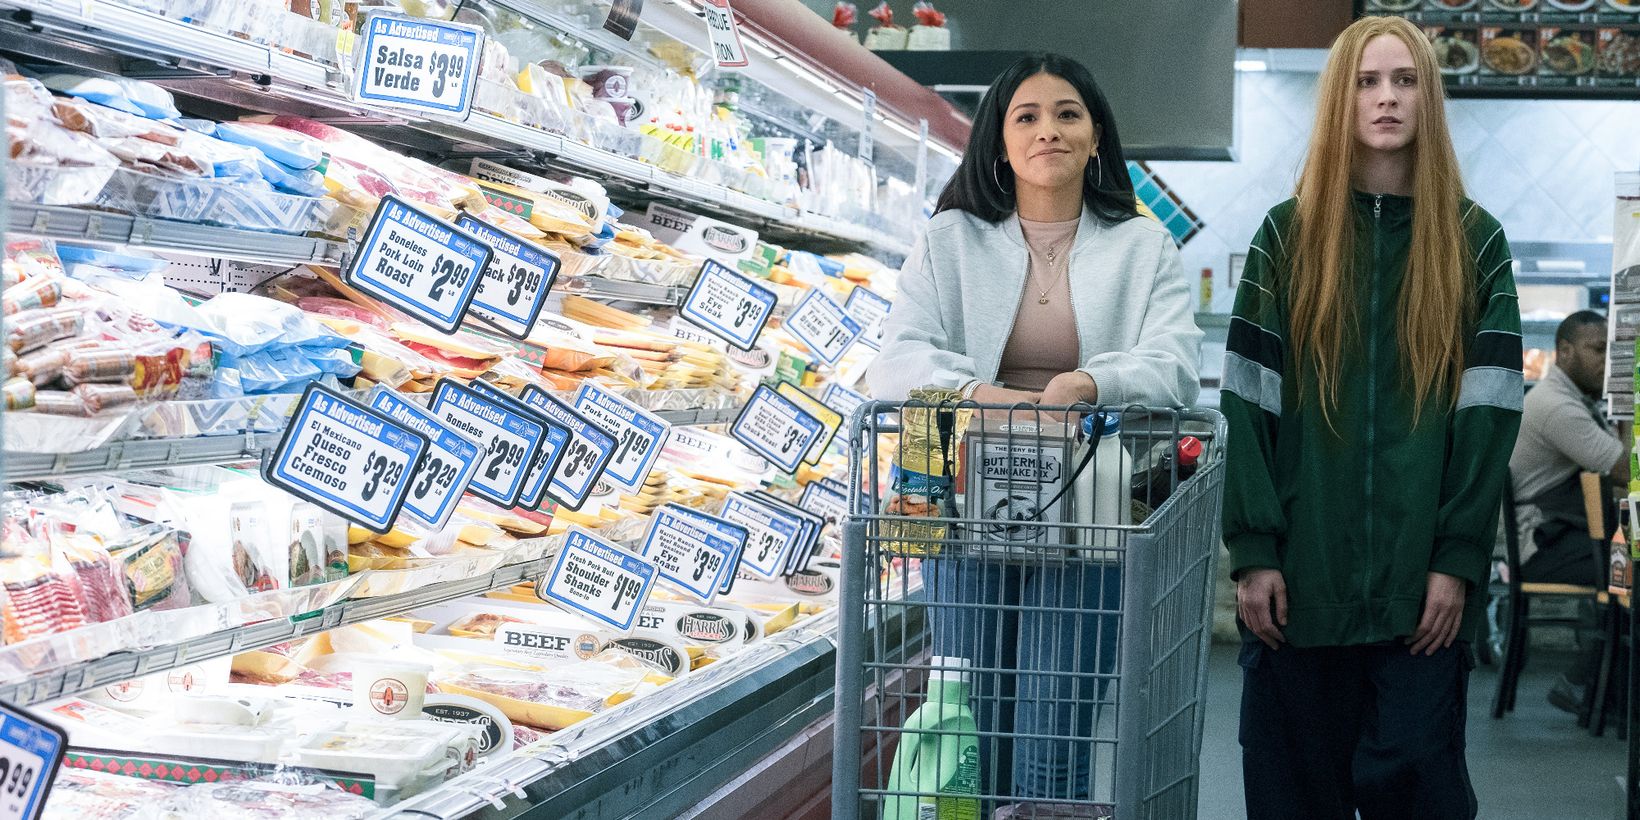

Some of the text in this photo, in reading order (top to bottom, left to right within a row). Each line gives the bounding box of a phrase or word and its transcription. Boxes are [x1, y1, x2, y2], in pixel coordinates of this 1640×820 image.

[374, 20, 388, 34] As
[389, 21, 439, 42] Advertised
[376, 45, 424, 70] Salsa
[374, 67, 420, 91] Verde
[389, 204, 452, 246] As Advertised
[651, 213, 693, 233] BEEF
[389, 230, 428, 256] Boneless
[464, 222, 520, 255] As Advertised
[379, 242, 424, 273] Pork Loin
[376, 257, 414, 288] Roast
[485, 267, 505, 282] ack
[700, 302, 723, 319] Steak
[707, 297, 723, 310] Eye
[312, 395, 383, 438] As Advertised
[444, 387, 458, 402] As
[458, 392, 504, 425] Advertised
[533, 392, 544, 404] As
[544, 396, 584, 431] Advertised
[584, 403, 602, 418] Pork
[604, 414, 620, 428] Loin
[585, 386, 636, 421] As Advertised
[378, 396, 443, 442] As Advertised
[446, 413, 484, 438] Boneless
[310, 420, 362, 450] El Mexicano
[311, 433, 350, 460] Queso
[302, 446, 347, 475] Fresco
[291, 456, 347, 492] Cremoso
[570, 534, 623, 567] As Advertised
[660, 550, 679, 564] Eye
[565, 562, 610, 588] Shoulder
[570, 552, 614, 578] Fresh Pork Butt
[564, 574, 602, 598] Shanks
[637, 616, 664, 629] EF
[683, 615, 730, 638] HARRIS
[504, 631, 571, 650] BEEF
[435, 708, 450, 716] EST.
